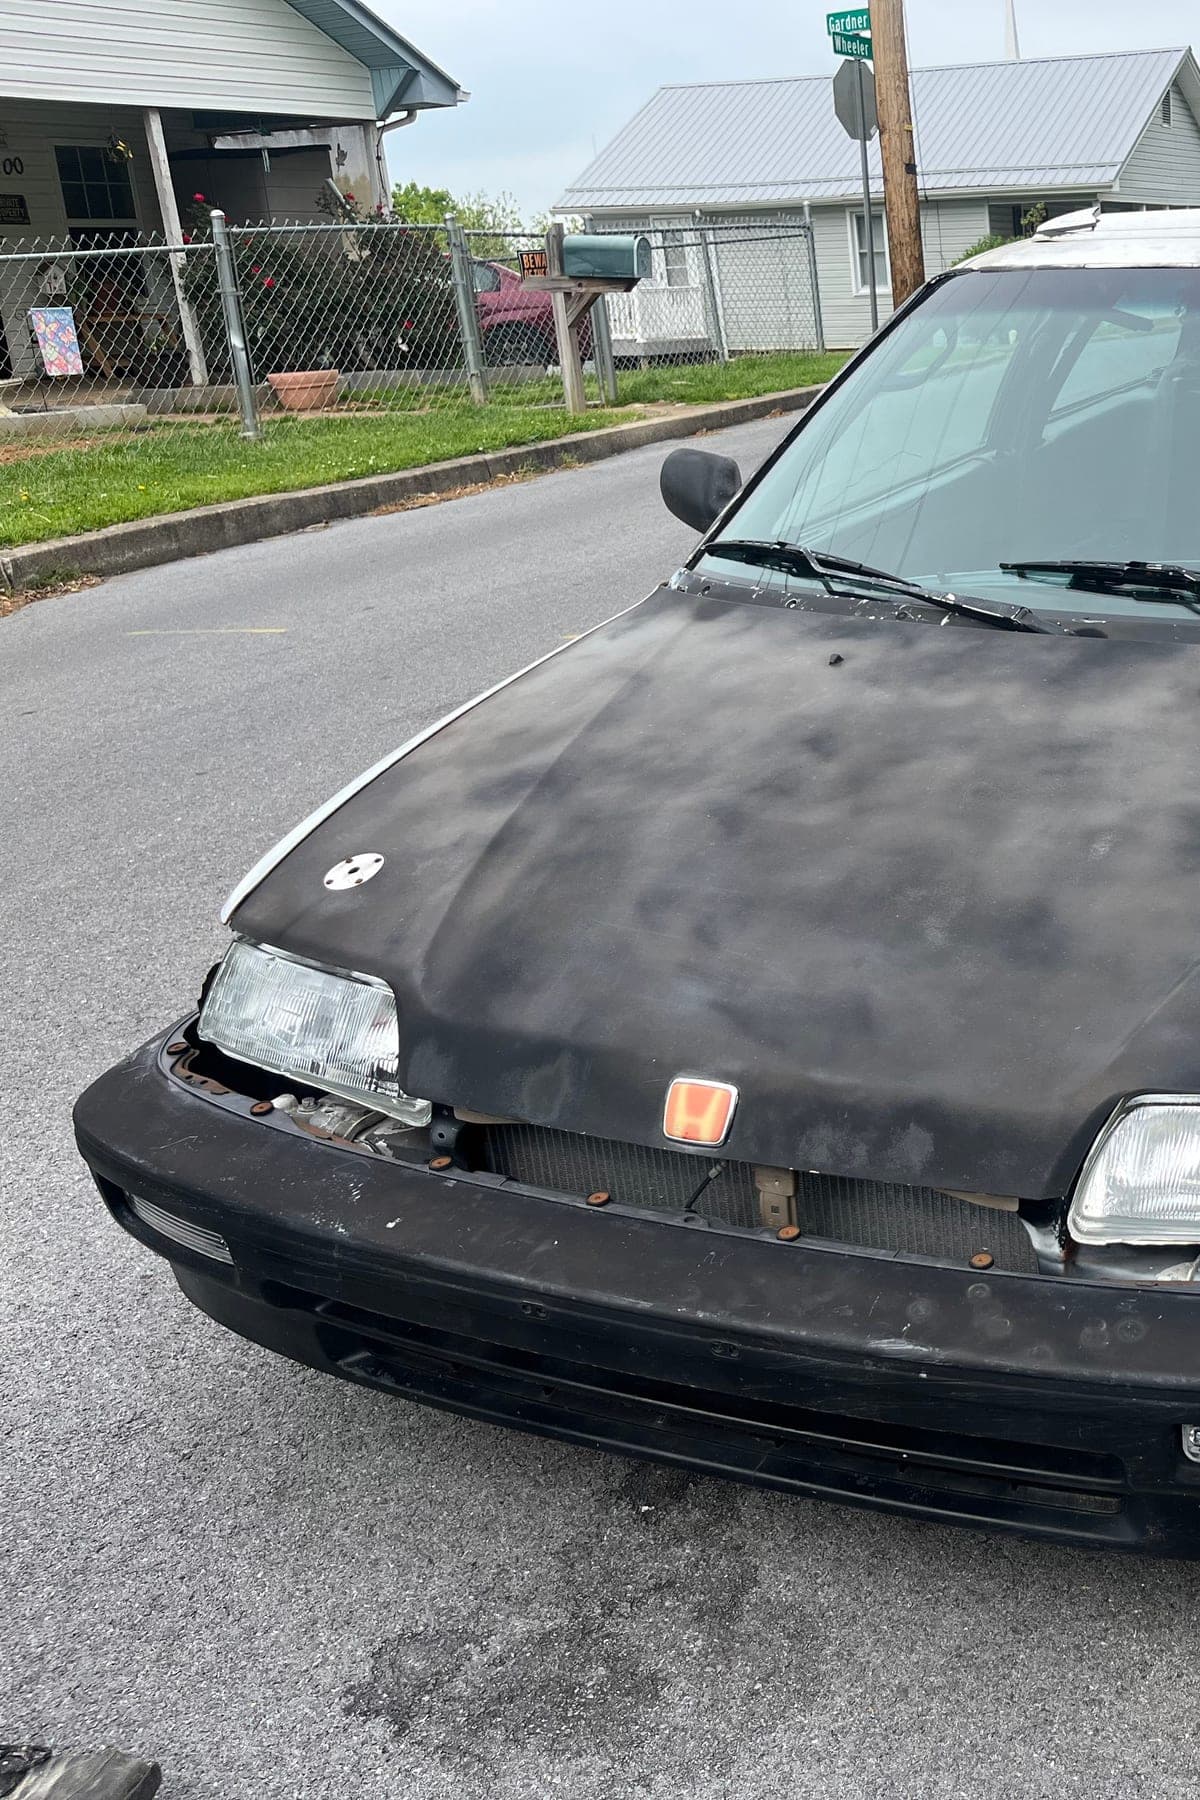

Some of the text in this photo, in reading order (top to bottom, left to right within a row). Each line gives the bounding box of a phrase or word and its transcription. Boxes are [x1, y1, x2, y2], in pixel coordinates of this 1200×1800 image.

[829, 15, 868, 32] Gardner
[834, 35, 869, 56] Wheeler
[522, 253, 547, 268] BEWA
